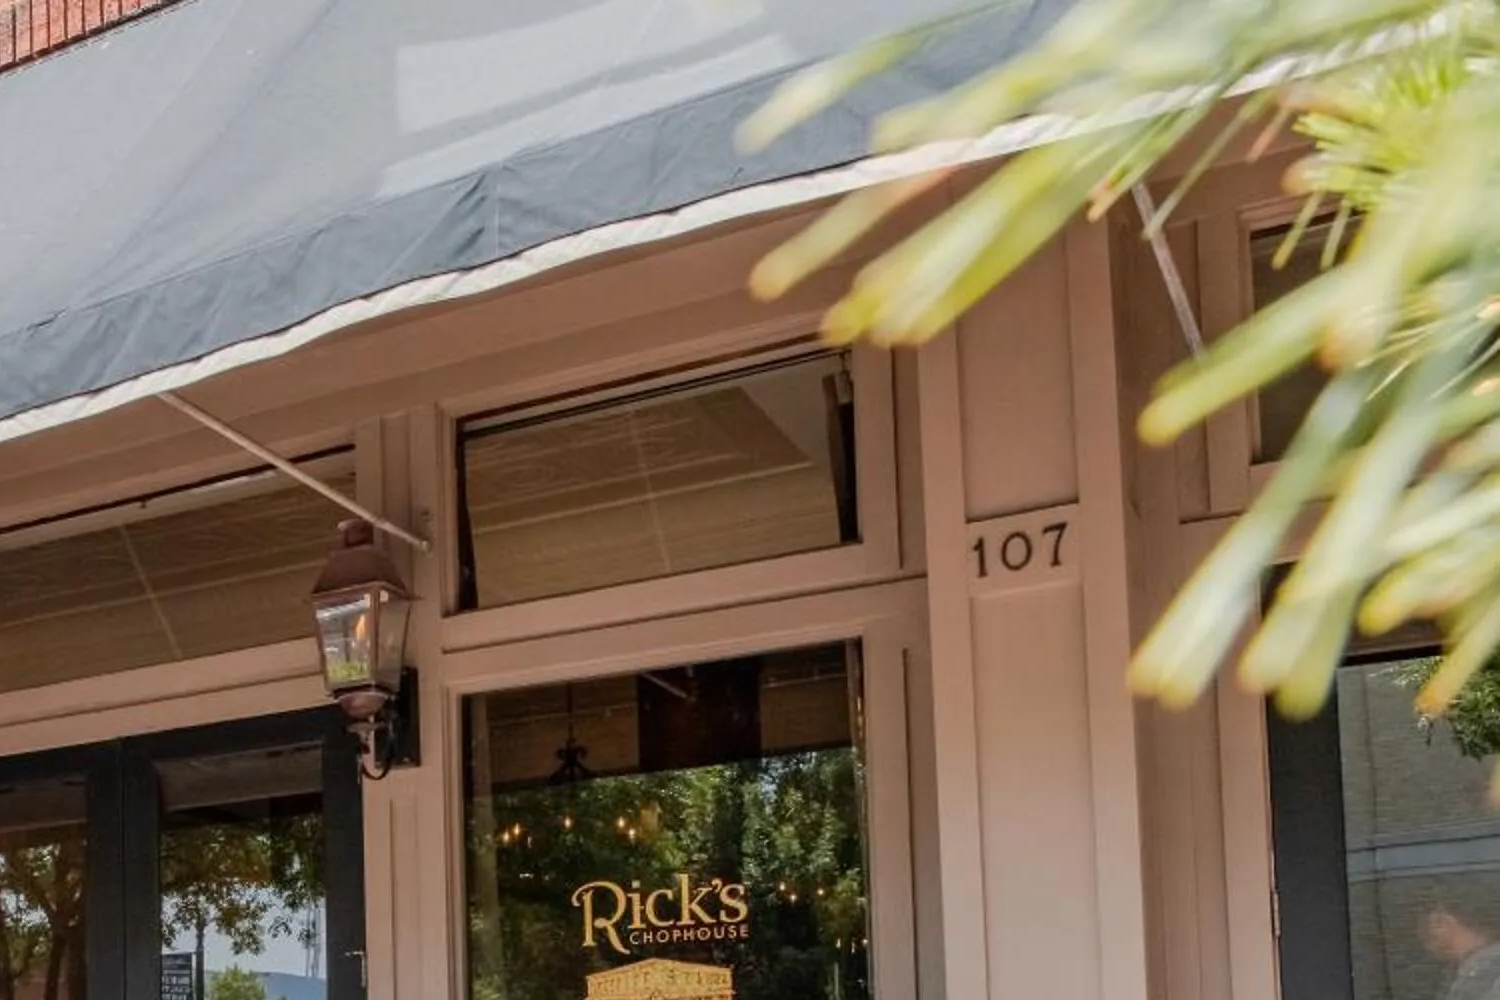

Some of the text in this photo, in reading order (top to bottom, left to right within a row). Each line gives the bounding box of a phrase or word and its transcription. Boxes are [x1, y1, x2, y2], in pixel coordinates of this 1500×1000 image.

[972, 520, 1068, 579] 107
[571, 872, 750, 956] Rick's
[628, 923, 750, 946] CHOPHOUSE
